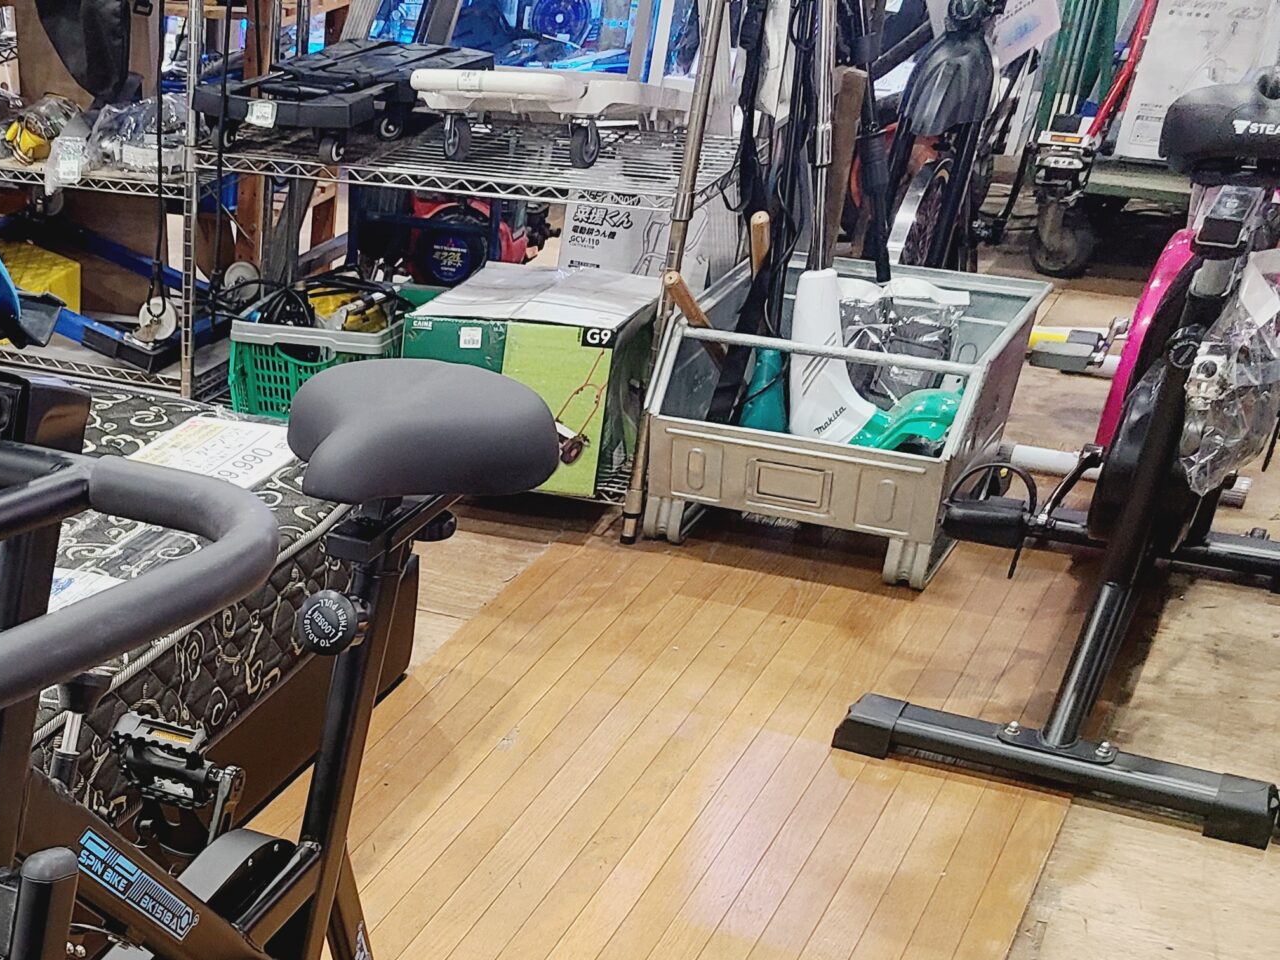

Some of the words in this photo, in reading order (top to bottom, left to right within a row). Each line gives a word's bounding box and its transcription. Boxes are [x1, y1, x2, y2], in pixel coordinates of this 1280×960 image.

[570, 235, 600, 246] GCV-110
[586, 328, 612, 345] G9
[814, 406, 846, 434] makita
[217, 447, 273, 480] 9,990
[319, 598, 339, 610] PULL
[304, 613, 319, 644] ADJUST
[312, 610, 336, 637] LOOSEN
[336, 608, 348, 631] THEN
[320, 639, 331, 647] TO
[78, 850, 105, 875] SPIN
[102, 867, 129, 891] BIKE
